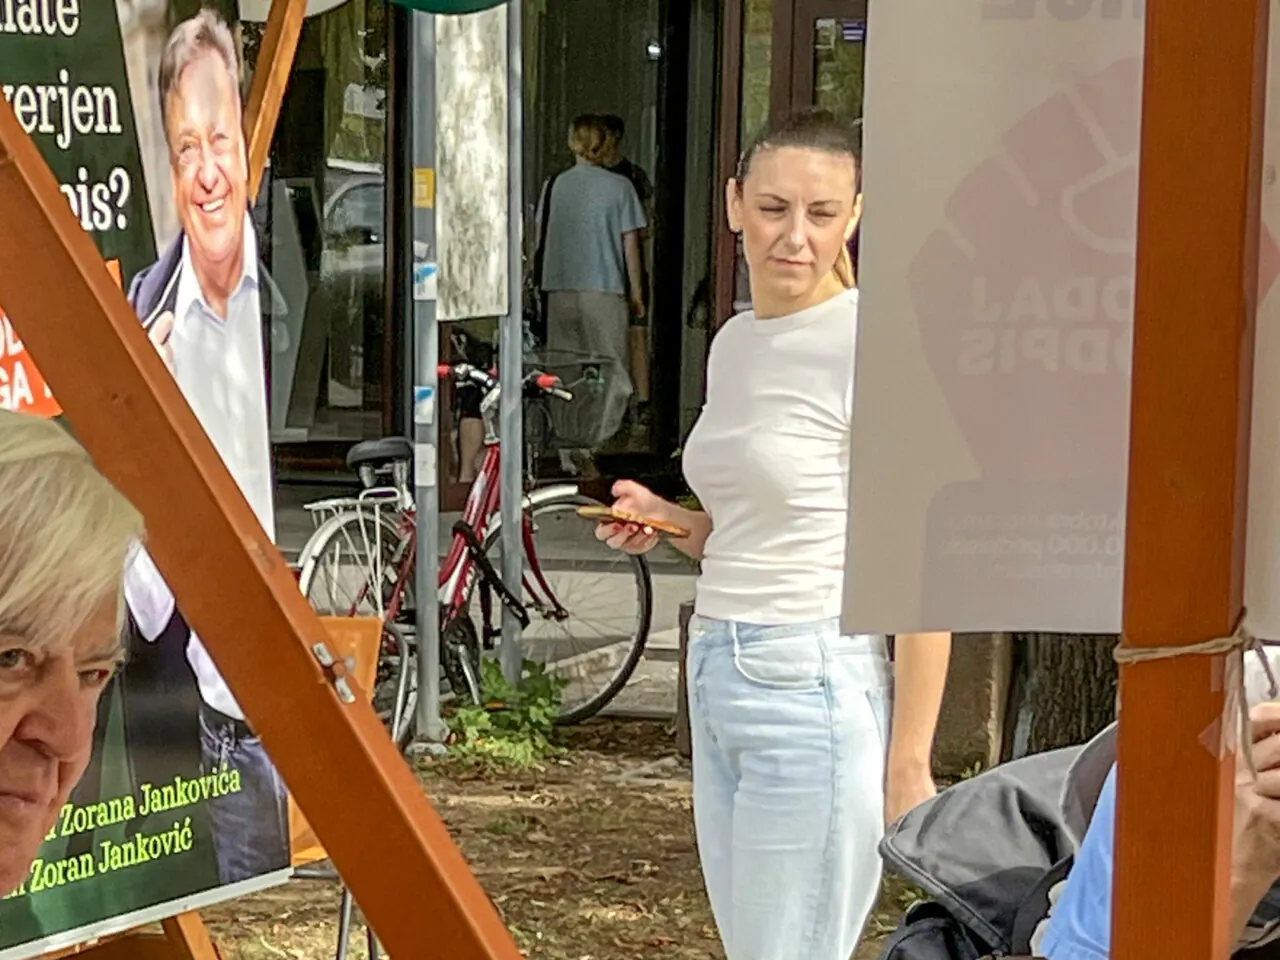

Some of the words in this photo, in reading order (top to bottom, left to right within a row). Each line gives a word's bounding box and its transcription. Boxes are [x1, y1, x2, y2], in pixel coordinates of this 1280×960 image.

[60, 795, 136, 837] Zorana
[139, 762, 241, 816] Jankovića
[29, 853, 95, 893] Zoran
[98, 816, 194, 873] Janković
